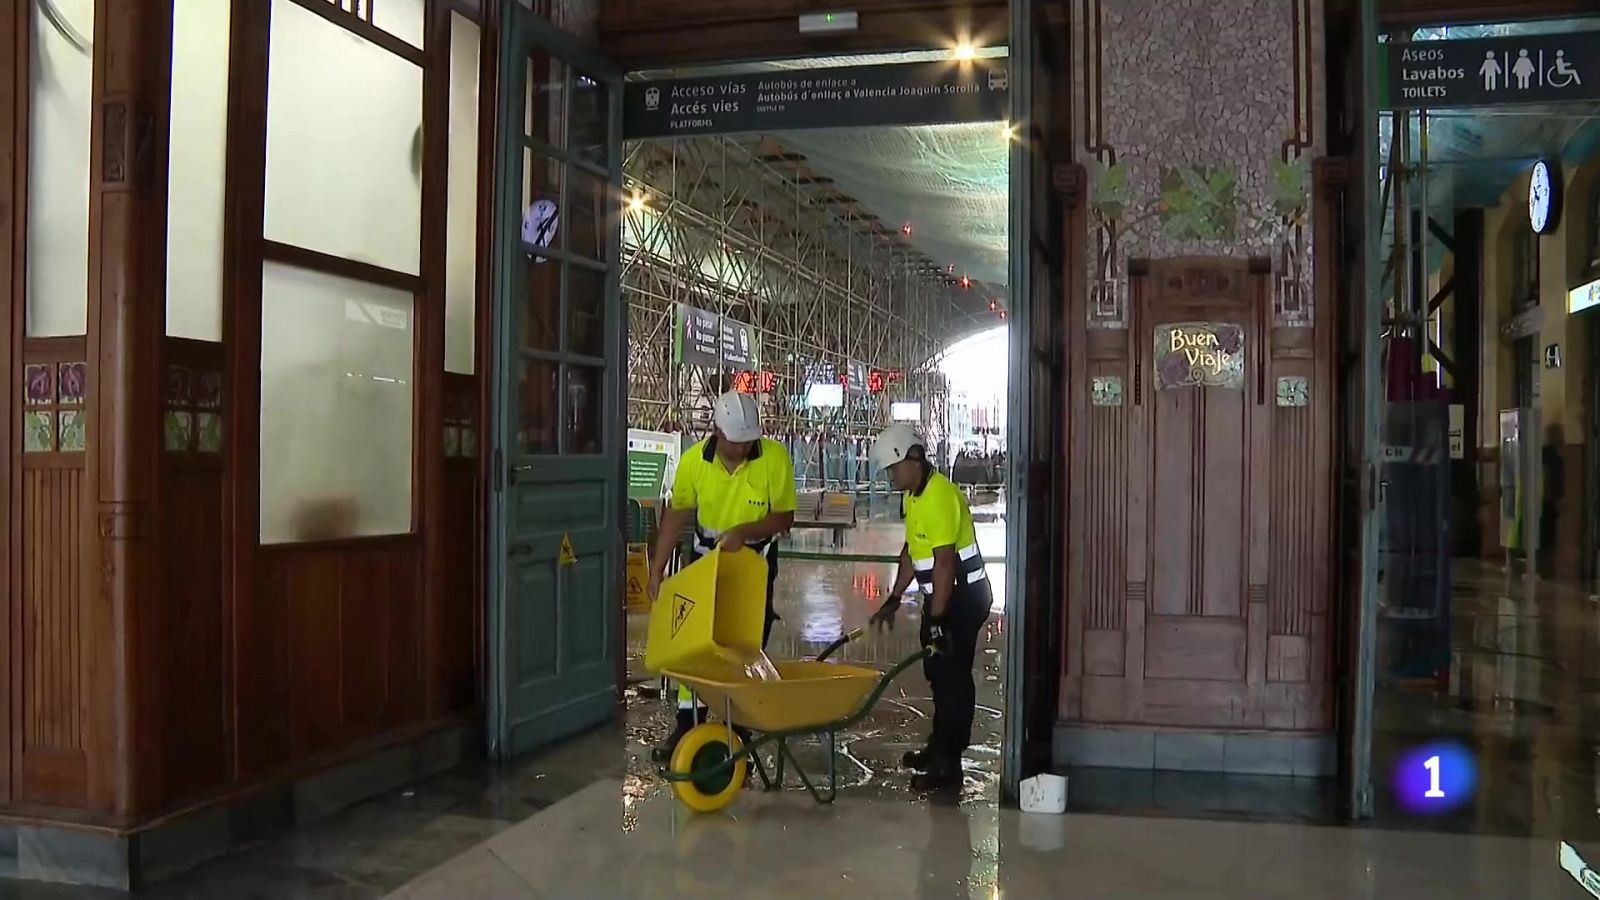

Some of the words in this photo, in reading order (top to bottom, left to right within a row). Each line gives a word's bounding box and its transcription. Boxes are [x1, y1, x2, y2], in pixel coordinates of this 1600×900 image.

[1402, 49, 1444, 62] Aseos
[1402, 67, 1465, 81] Lavabos
[671, 85, 714, 98] Acceso
[720, 81, 746, 95] vías
[758, 80, 798, 90] Autobús
[800, 79, 812, 88] de
[816, 78, 848, 88] enlace
[758, 91, 798, 102] Autobús
[844, 90, 851, 98] a
[853, 87, 896, 98] Valencia
[899, 85, 941, 96] Joaquín
[943, 83, 980, 93] Sorolla
[1402, 86, 1447, 98] TOILETS
[671, 101, 707, 115] Accés
[712, 100, 739, 113] vies
[670, 119, 713, 129] PLATFORMS
[1170, 329, 1220, 352] Buen
